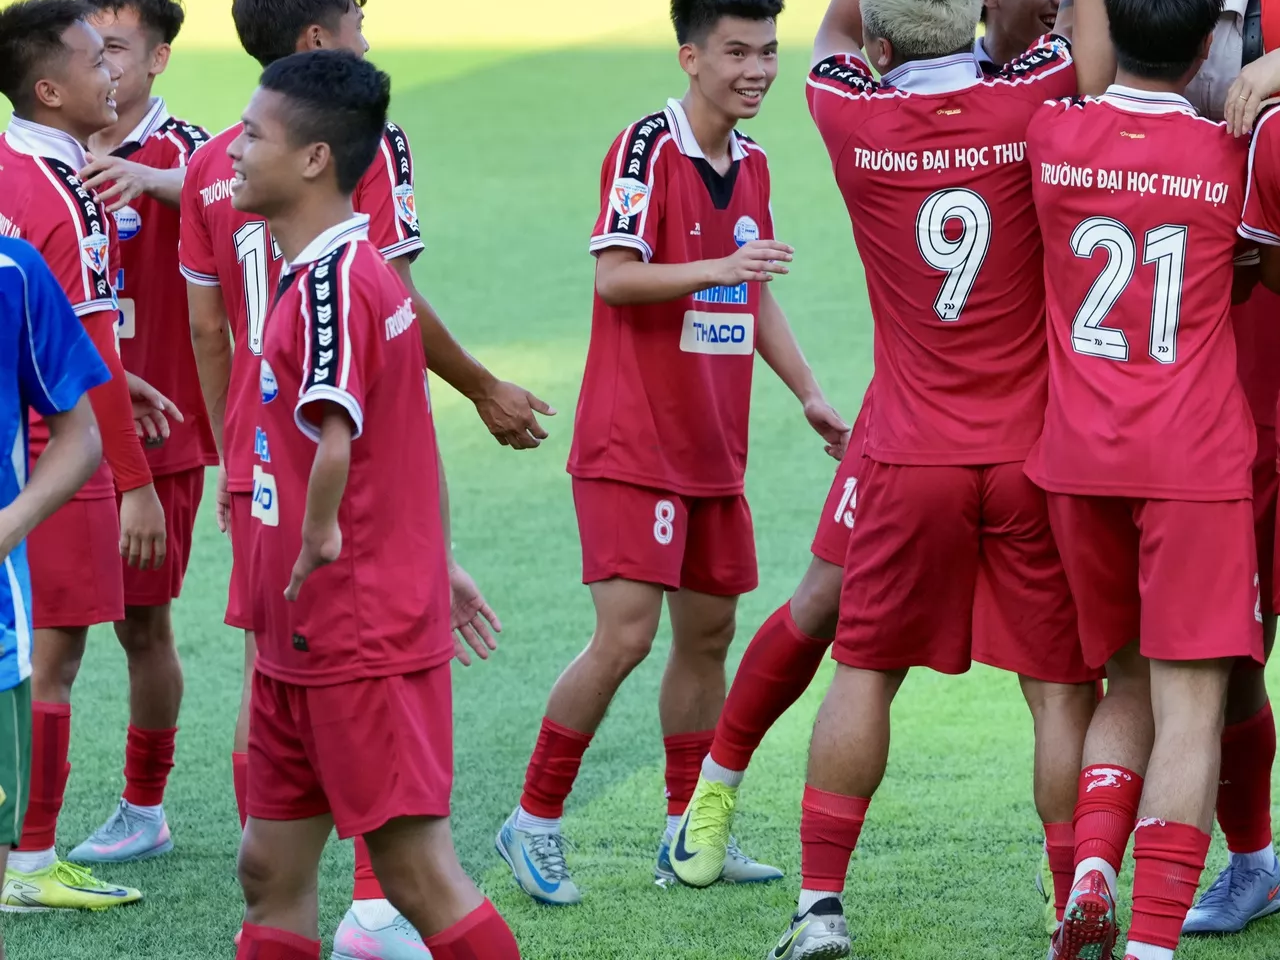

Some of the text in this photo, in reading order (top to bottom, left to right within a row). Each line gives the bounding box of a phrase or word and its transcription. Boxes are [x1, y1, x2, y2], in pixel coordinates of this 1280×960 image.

[854, 141, 1027, 174] TRƯỜNG ĐẠI HỌC THU
[1040, 161, 1229, 208] TRƯỜNG ĐẠI HỌC THUỶ LỢI
[915, 187, 992, 321] 9
[232, 220, 284, 356] 1
[1070, 216, 1188, 364] 21
[693, 323, 745, 343] THACO
[653, 499, 675, 545] 8
